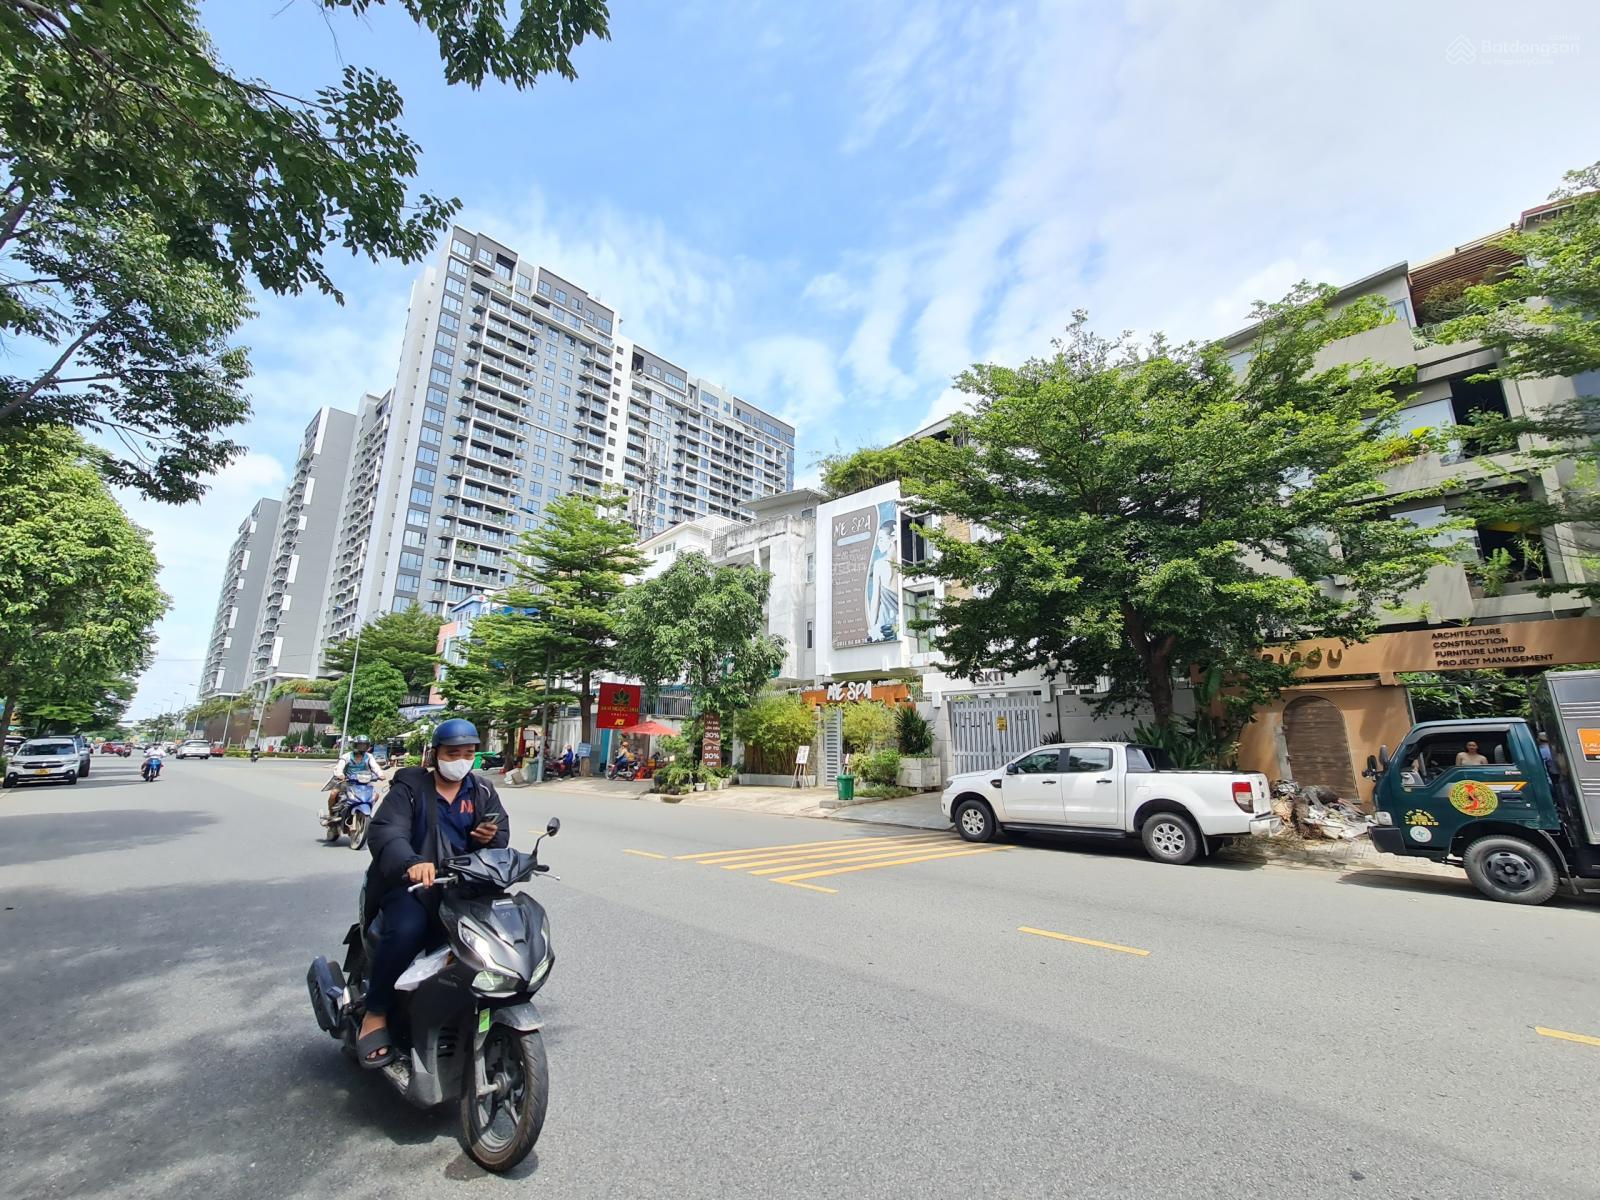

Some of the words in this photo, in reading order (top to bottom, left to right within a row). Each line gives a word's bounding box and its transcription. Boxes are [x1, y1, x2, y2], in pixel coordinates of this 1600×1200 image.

[851, 514, 871, 532] SPA
[1431, 628, 1501, 639] ARCHITECTURE
[1433, 637, 1508, 649] CONSTRUCTION
[1435, 648, 1486, 658] FURNITURE
[1488, 645, 1525, 655] LIMITED
[1437, 657, 1481, 667] PROJECT
[1483, 653, 1554, 664] MANAGEMENT
[847, 680, 872, 700] SPA
[705, 731, 720, 739] 30%
